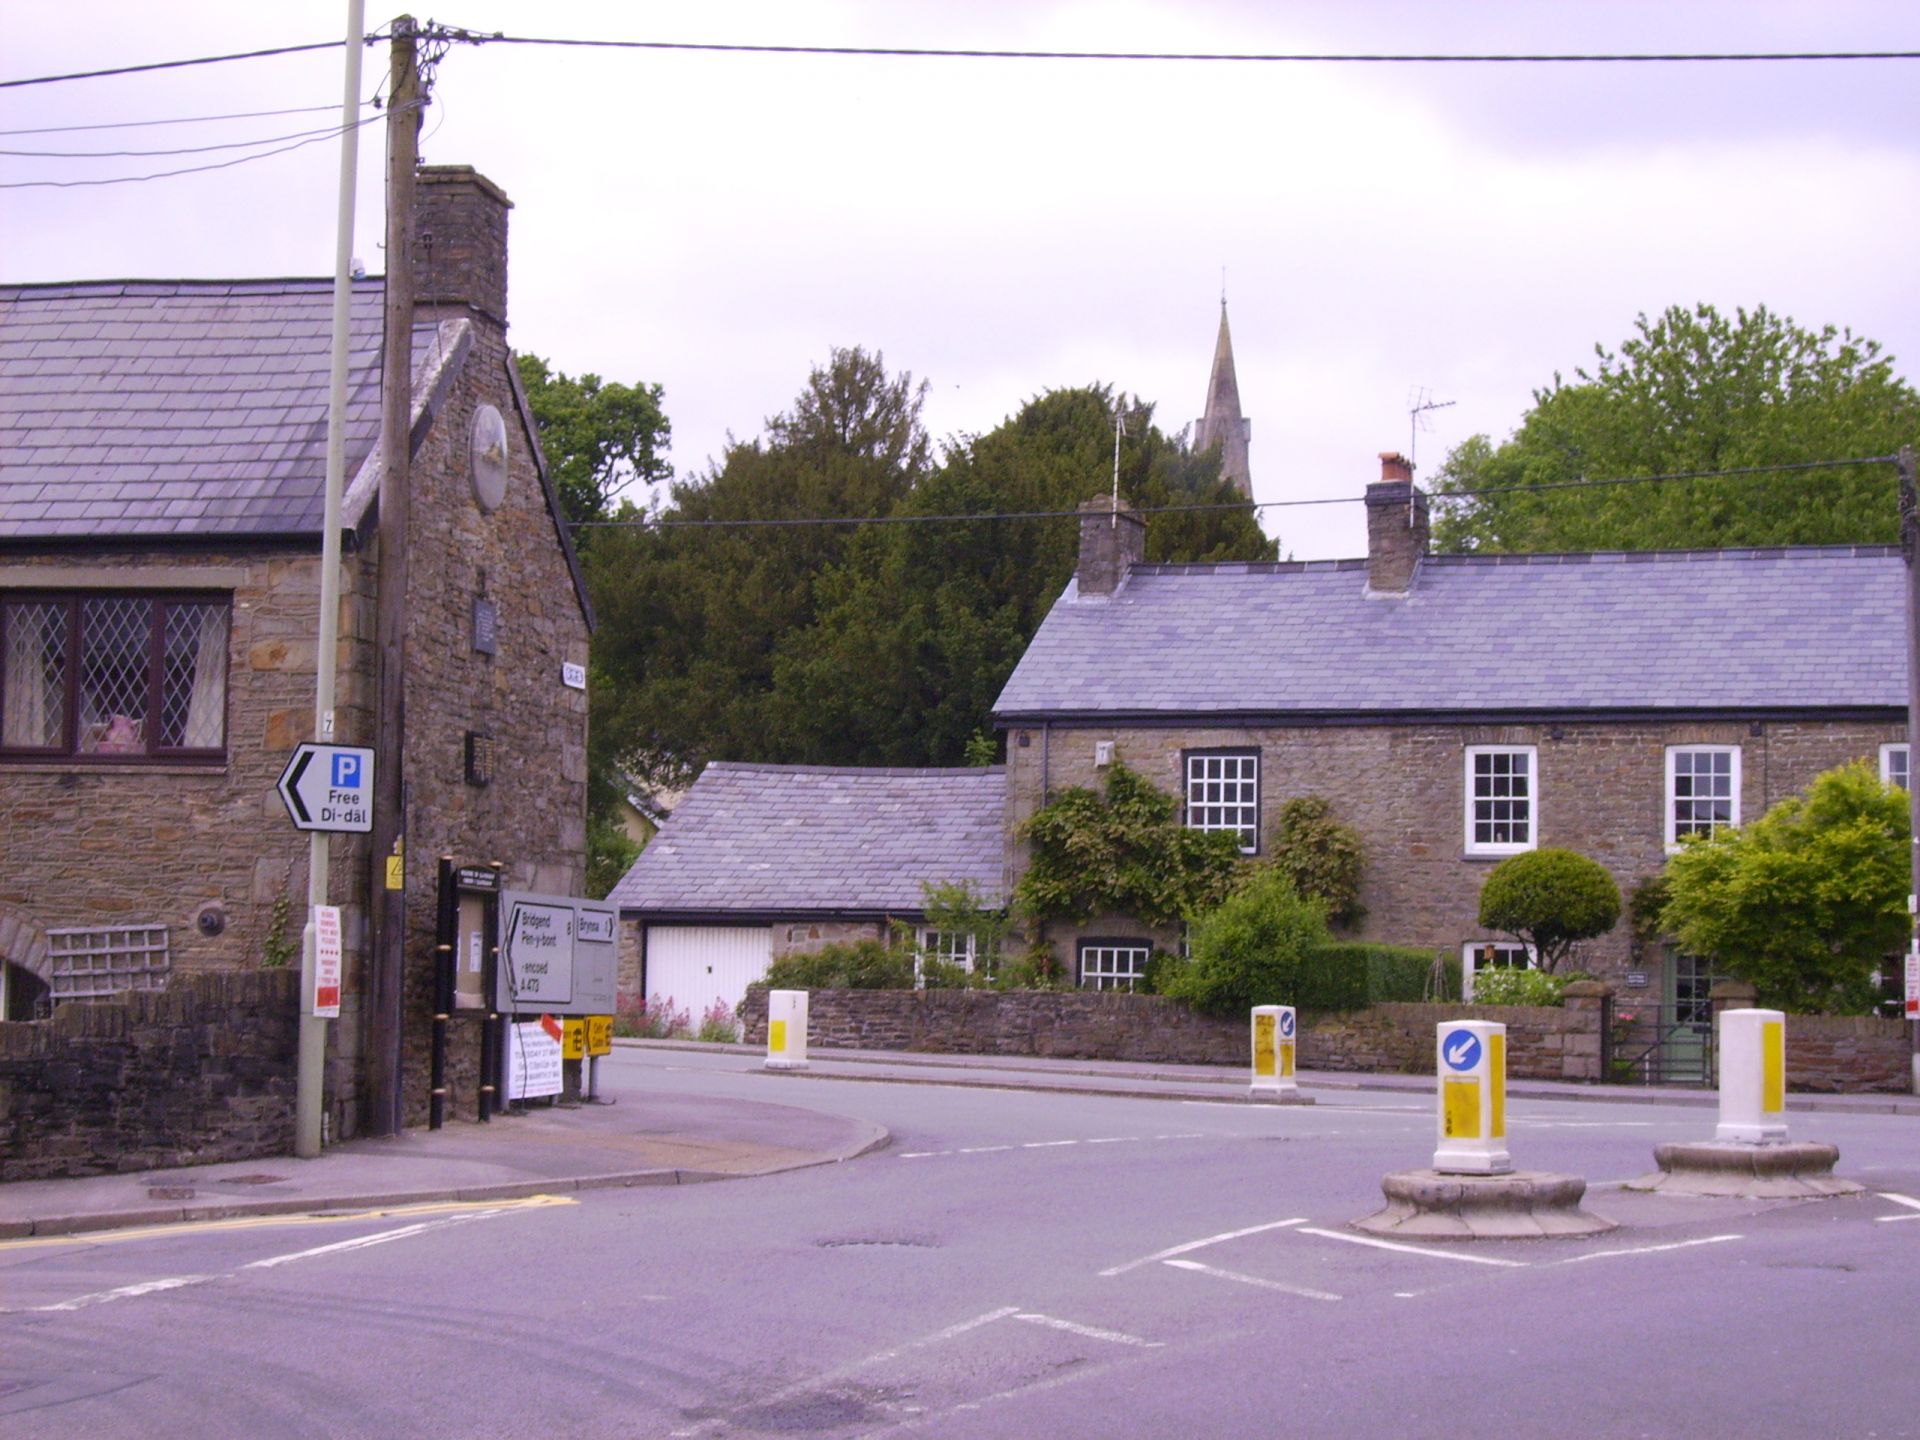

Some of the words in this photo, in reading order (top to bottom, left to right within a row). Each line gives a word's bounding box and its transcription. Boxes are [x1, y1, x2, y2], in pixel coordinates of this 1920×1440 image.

[338, 757, 357, 785] P
[329, 790, 360, 805] Free
[321, 808, 366, 823] Di-dâl
[522, 912, 551, 929] Bridgend
